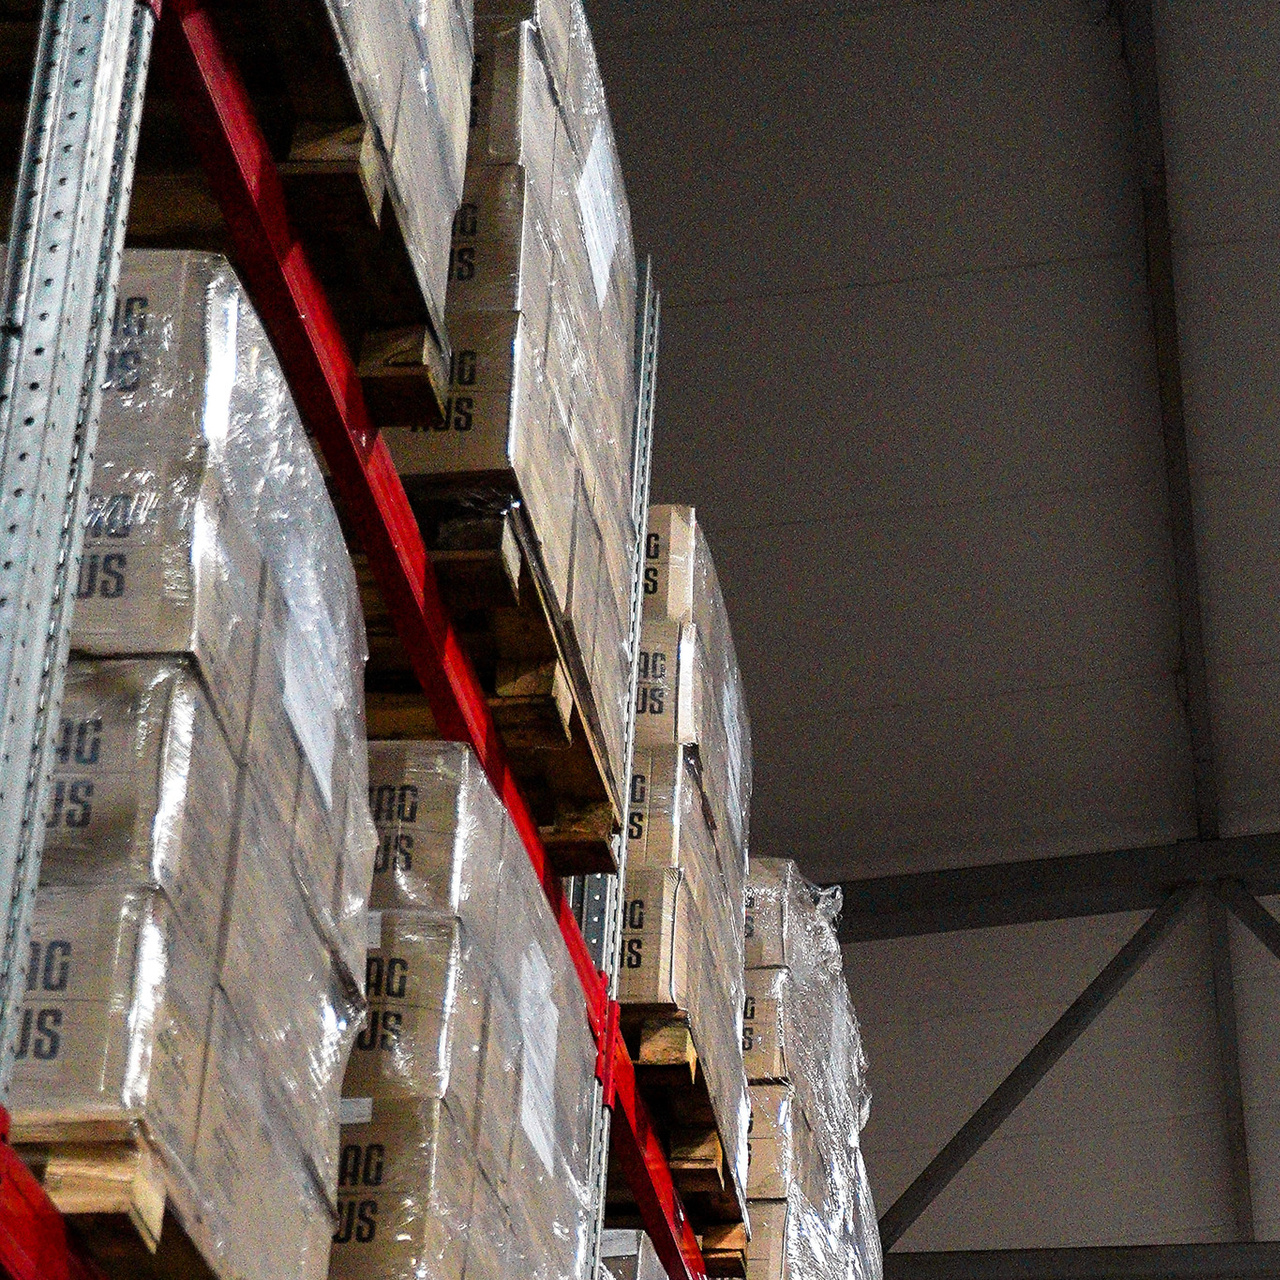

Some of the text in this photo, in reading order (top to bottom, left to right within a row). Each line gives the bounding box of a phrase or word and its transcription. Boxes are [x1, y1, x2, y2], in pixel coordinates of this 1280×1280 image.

[77, 553, 126, 599] US
[639, 652, 666, 678] AG
[636, 686, 664, 714] US
[374, 834, 414, 874] US
[366, 957, 408, 998] AG
[358, 1011, 402, 1051] US
[338, 1144, 385, 1187] AG
[332, 1200, 378, 1243] US
